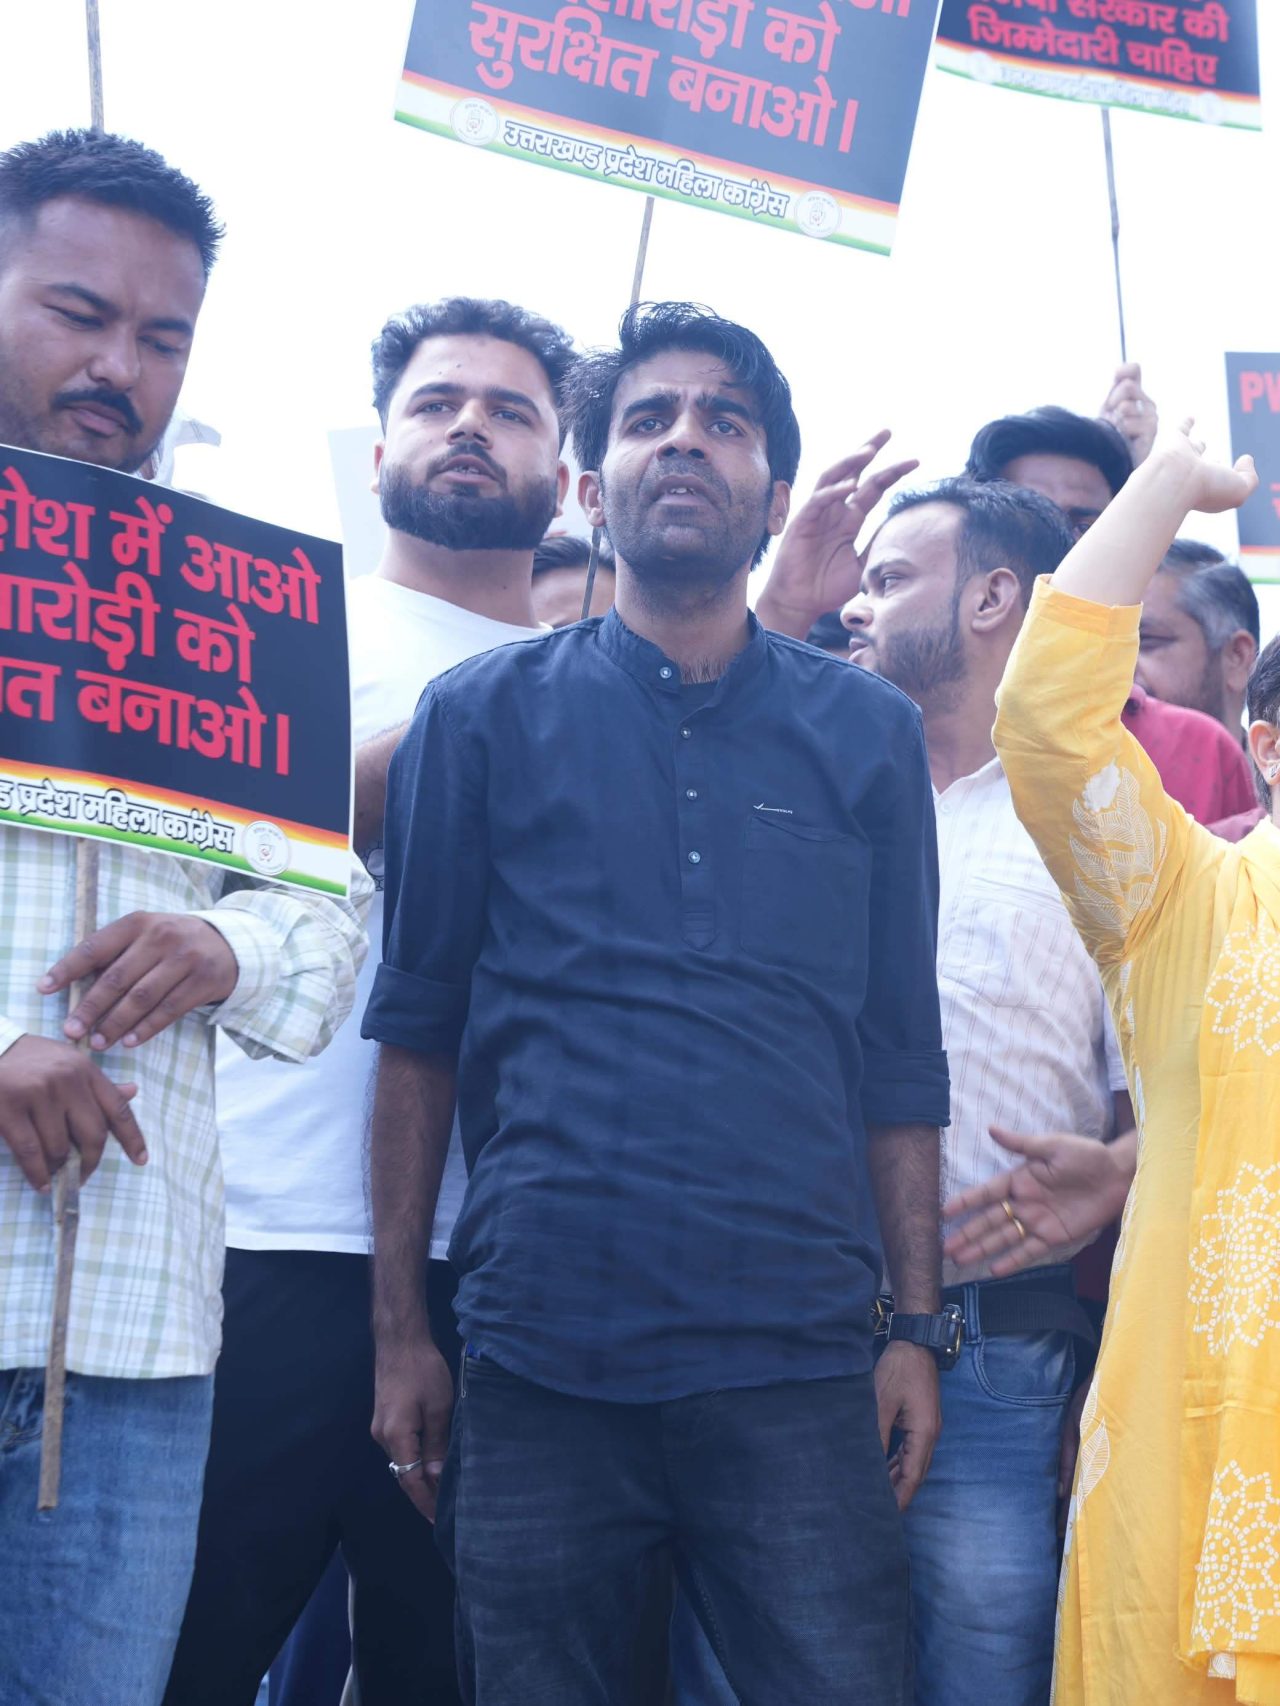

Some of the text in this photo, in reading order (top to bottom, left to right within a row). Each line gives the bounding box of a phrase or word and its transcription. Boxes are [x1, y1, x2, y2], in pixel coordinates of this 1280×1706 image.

[469, 2, 660, 97] सुरक्षित
[763, 1, 842, 72] को
[1125, 37, 1219, 85] चाहिए
[1182, 2, 1230, 42] की
[503, 121, 791, 218] उत्तराखण्ड प्रदेश महिला कांग्रेस
[109, 495, 174, 577] में
[179, 534, 322, 625] आओ
[173, 603, 257, 684] को
[18, 777, 81, 819] प्रदेश
[82, 787, 160, 837] महिला
[161, 807, 236, 854] कांग्रेस
